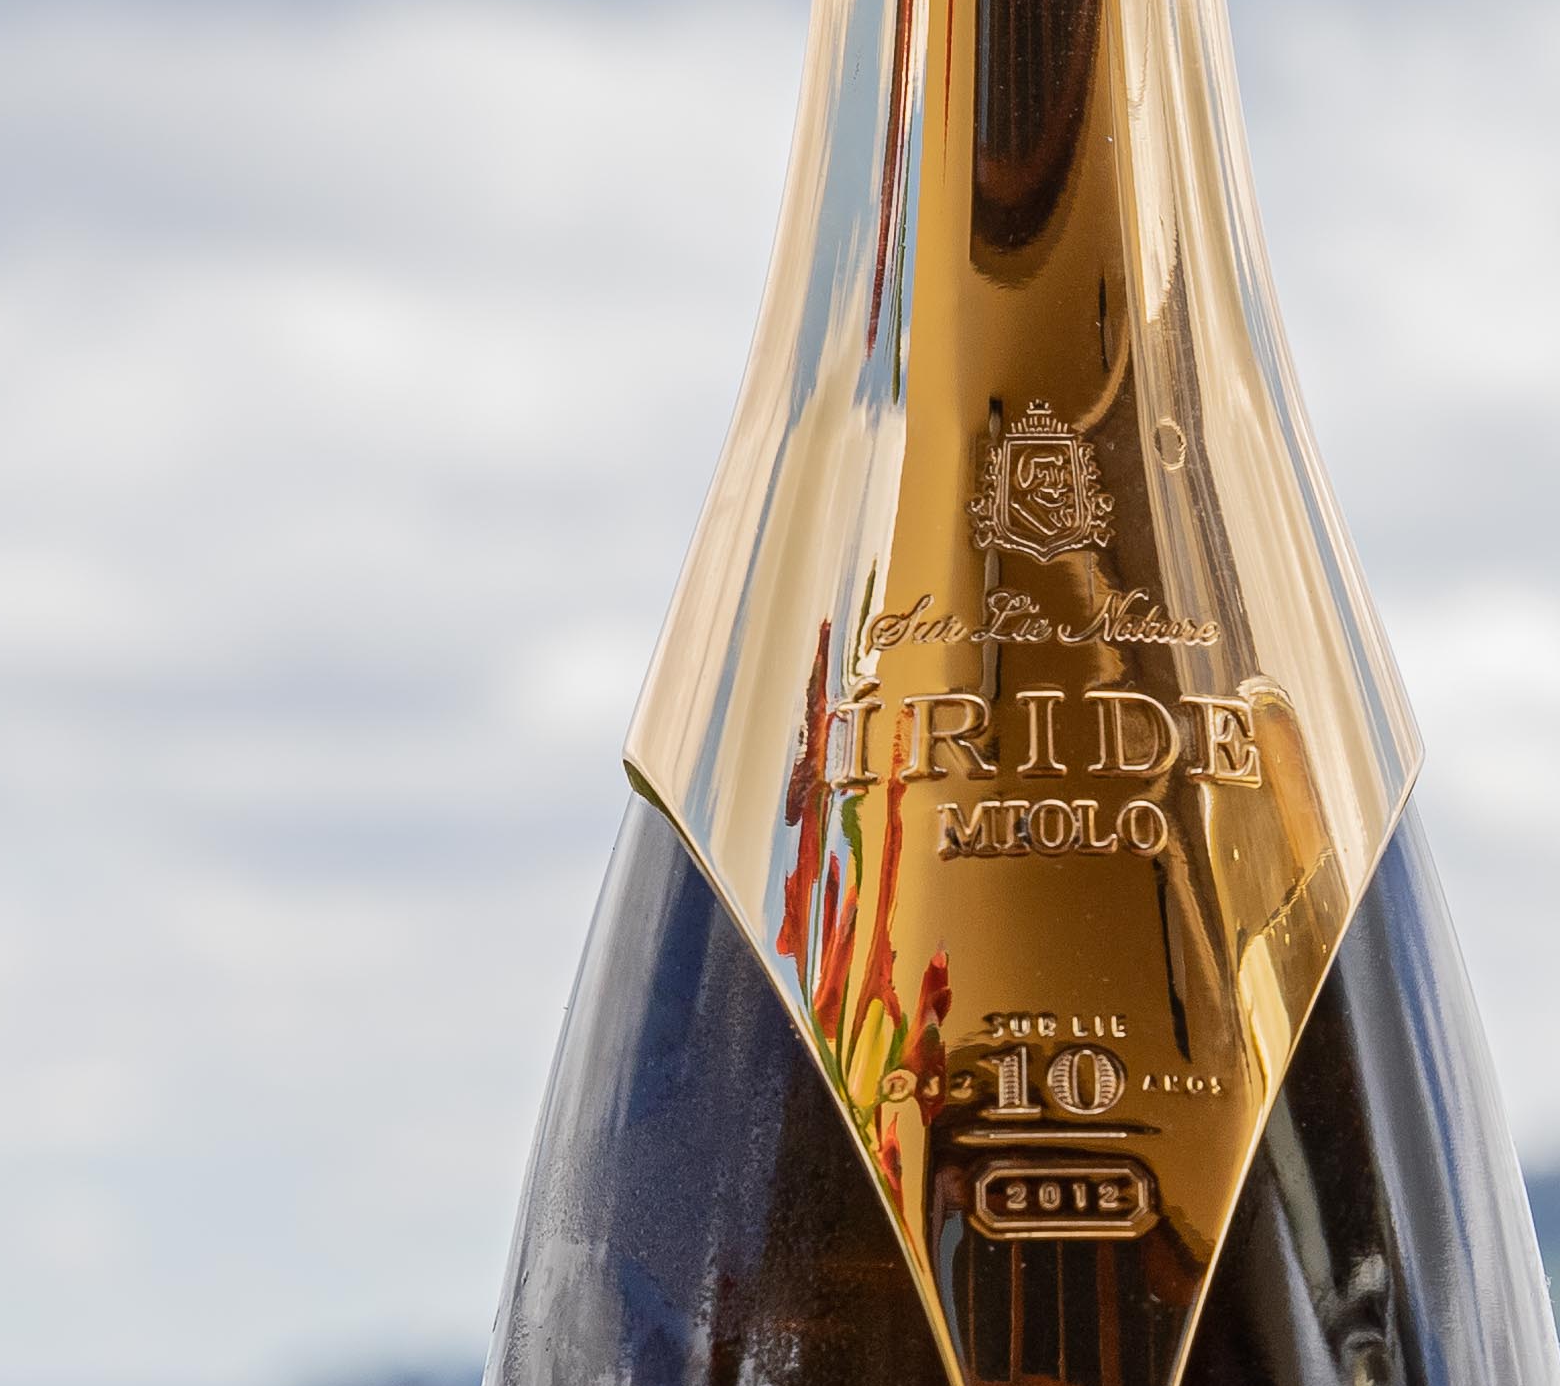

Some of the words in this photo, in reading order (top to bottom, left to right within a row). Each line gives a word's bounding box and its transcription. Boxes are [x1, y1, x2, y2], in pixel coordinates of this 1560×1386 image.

[866, 593, 968, 651] Sur
[1056, 588, 1222, 646] Nature
[830, 677, 1263, 790] ÍRIDE
[937, 797, 1169, 860] MIOLO
[1071, 1014, 1128, 1038] LIE
[980, 1045, 1127, 1118] 10
[1005, 1181, 1121, 1210] 2012
